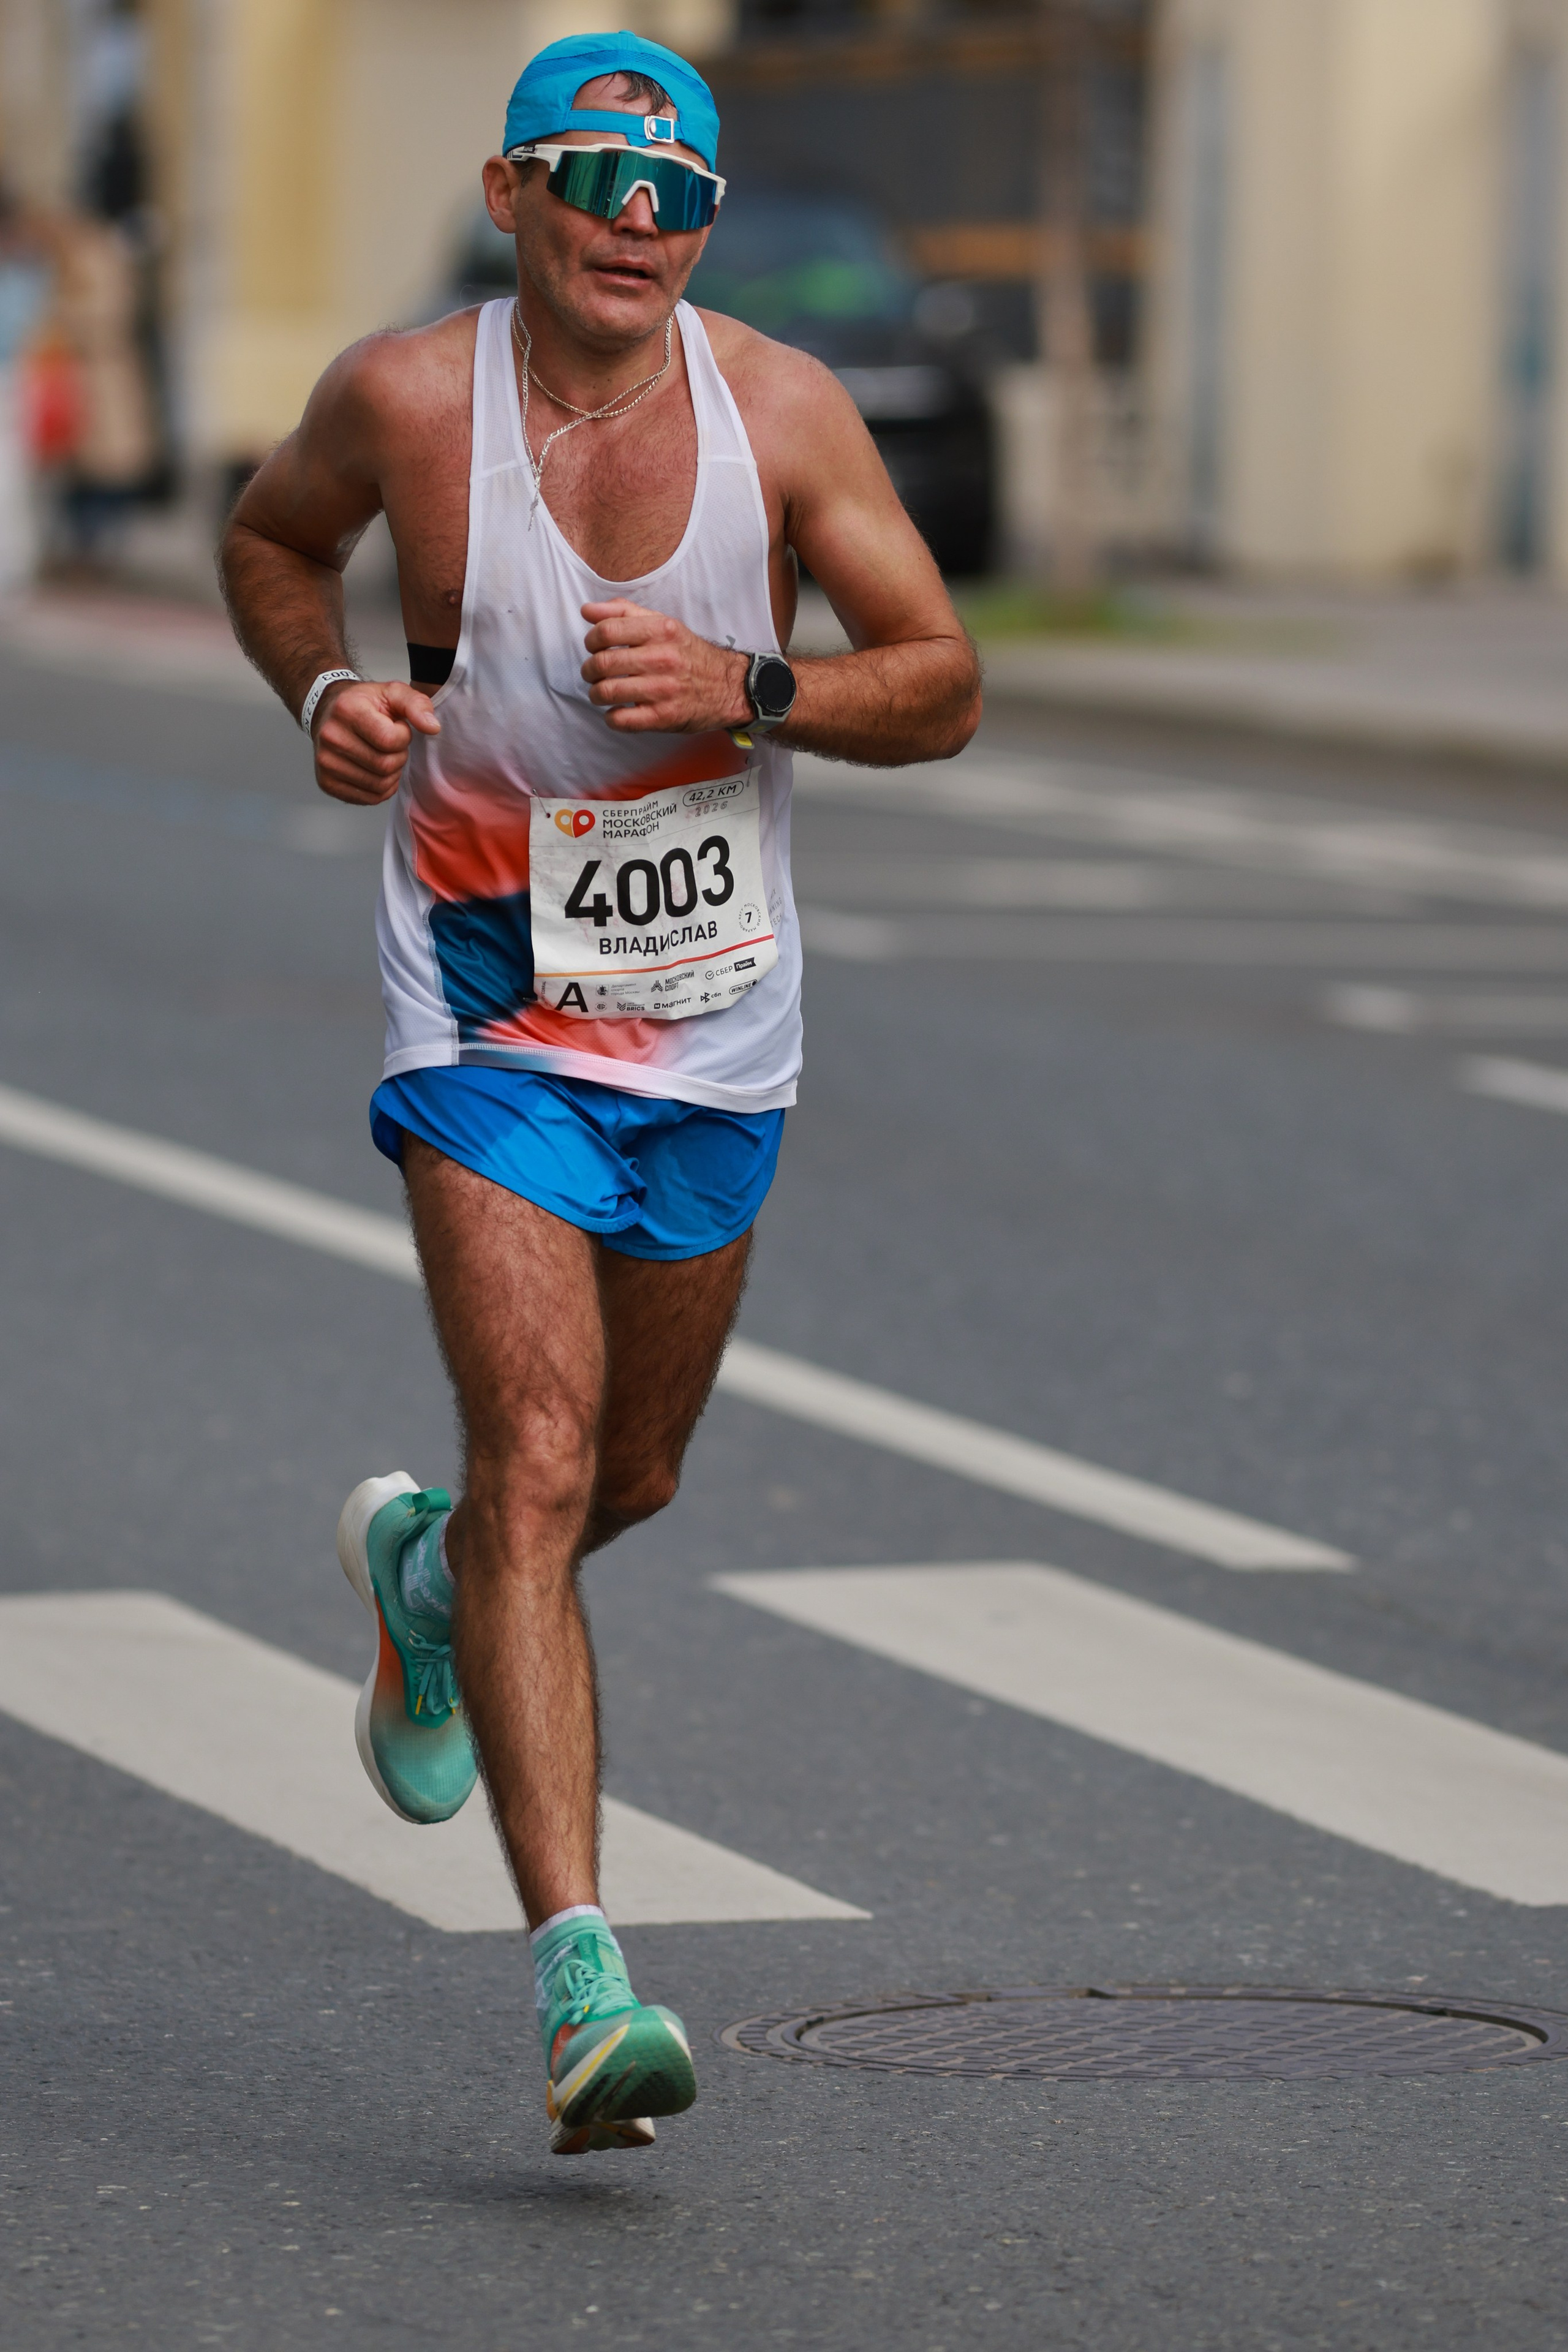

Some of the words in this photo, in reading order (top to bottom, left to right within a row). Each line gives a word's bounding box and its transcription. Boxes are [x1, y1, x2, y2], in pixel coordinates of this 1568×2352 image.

[307, 690, 318, 715] 42,2
[689, 790, 713, 802] 42,2
[602, 801, 658, 817] СБЕРПРАЙМ
[603, 804, 677, 827] МОСКОВСКИЙ
[695, 801, 728, 817] 2026
[603, 821, 659, 839] МАРАФОН
[565, 835, 734, 927] 4003
[745, 911, 752, 924] 7
[599, 921, 718, 957] ВЛАДИСЛАВ
[715, 965, 733, 976] СБЕР
[736, 960, 752, 970] Прайм
[665, 970, 695, 985] МОСКОВСКИЙ
[731, 982, 752, 993] WINLINE
[554, 982, 589, 1012] A
